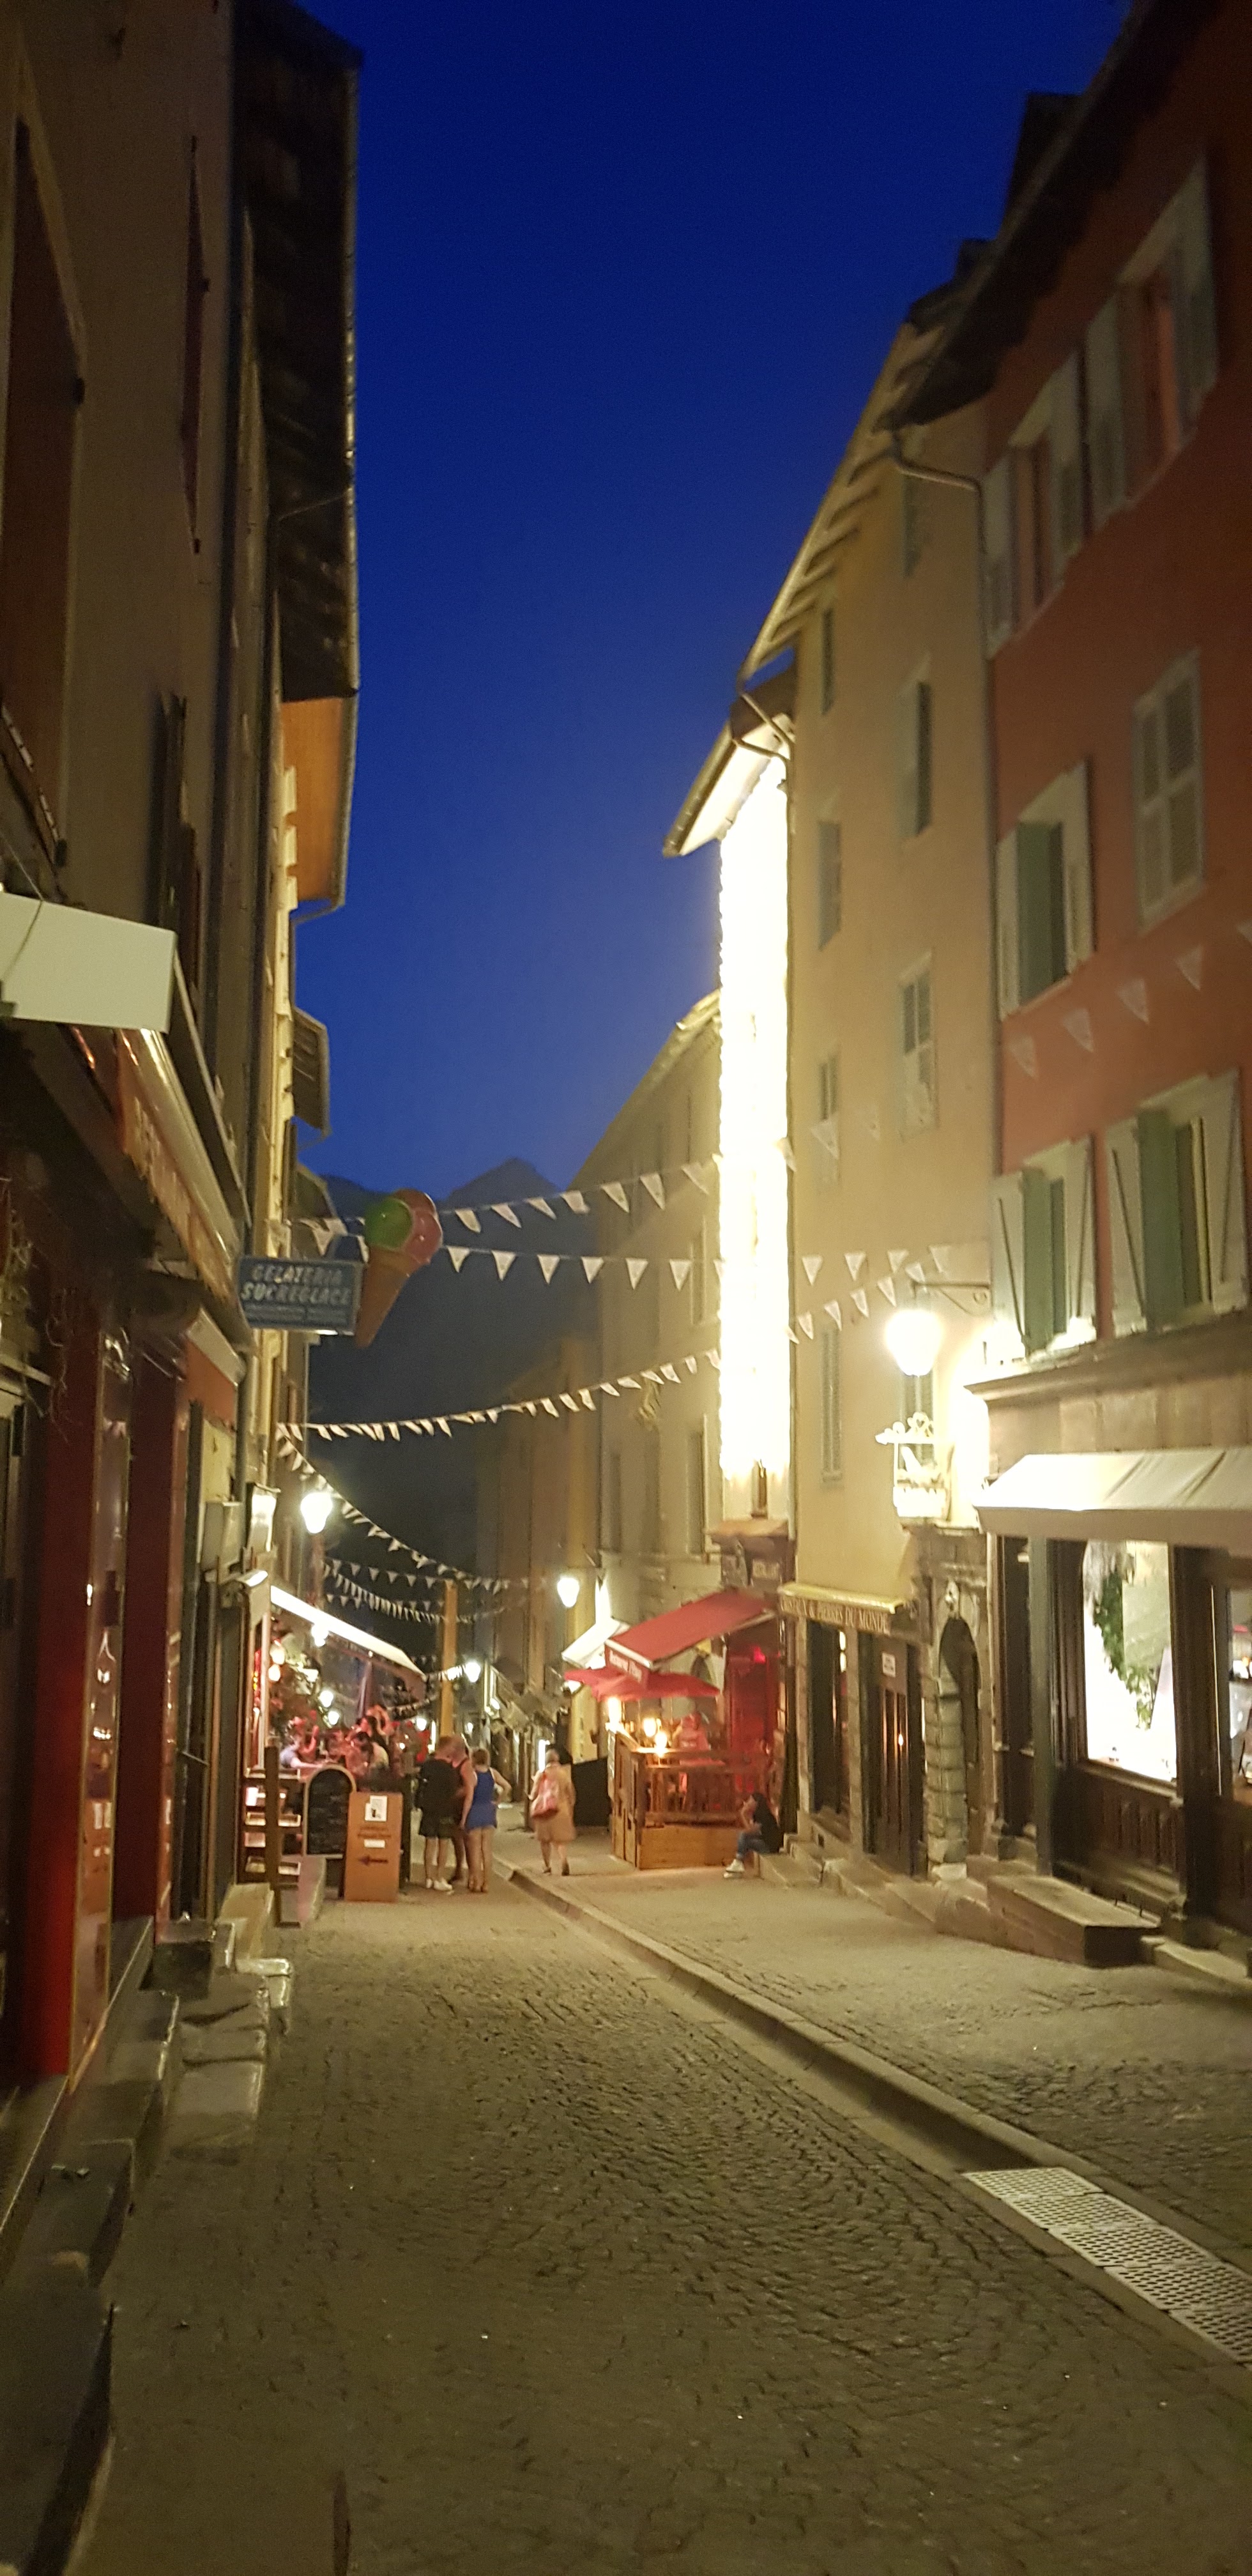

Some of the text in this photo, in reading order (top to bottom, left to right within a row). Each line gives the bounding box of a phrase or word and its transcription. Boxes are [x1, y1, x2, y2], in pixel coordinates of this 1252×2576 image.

[252, 1263, 342, 1285] GELATERIA
[845, 1604, 857, 1628] DU
[859, 1607, 891, 1636] MONDE
